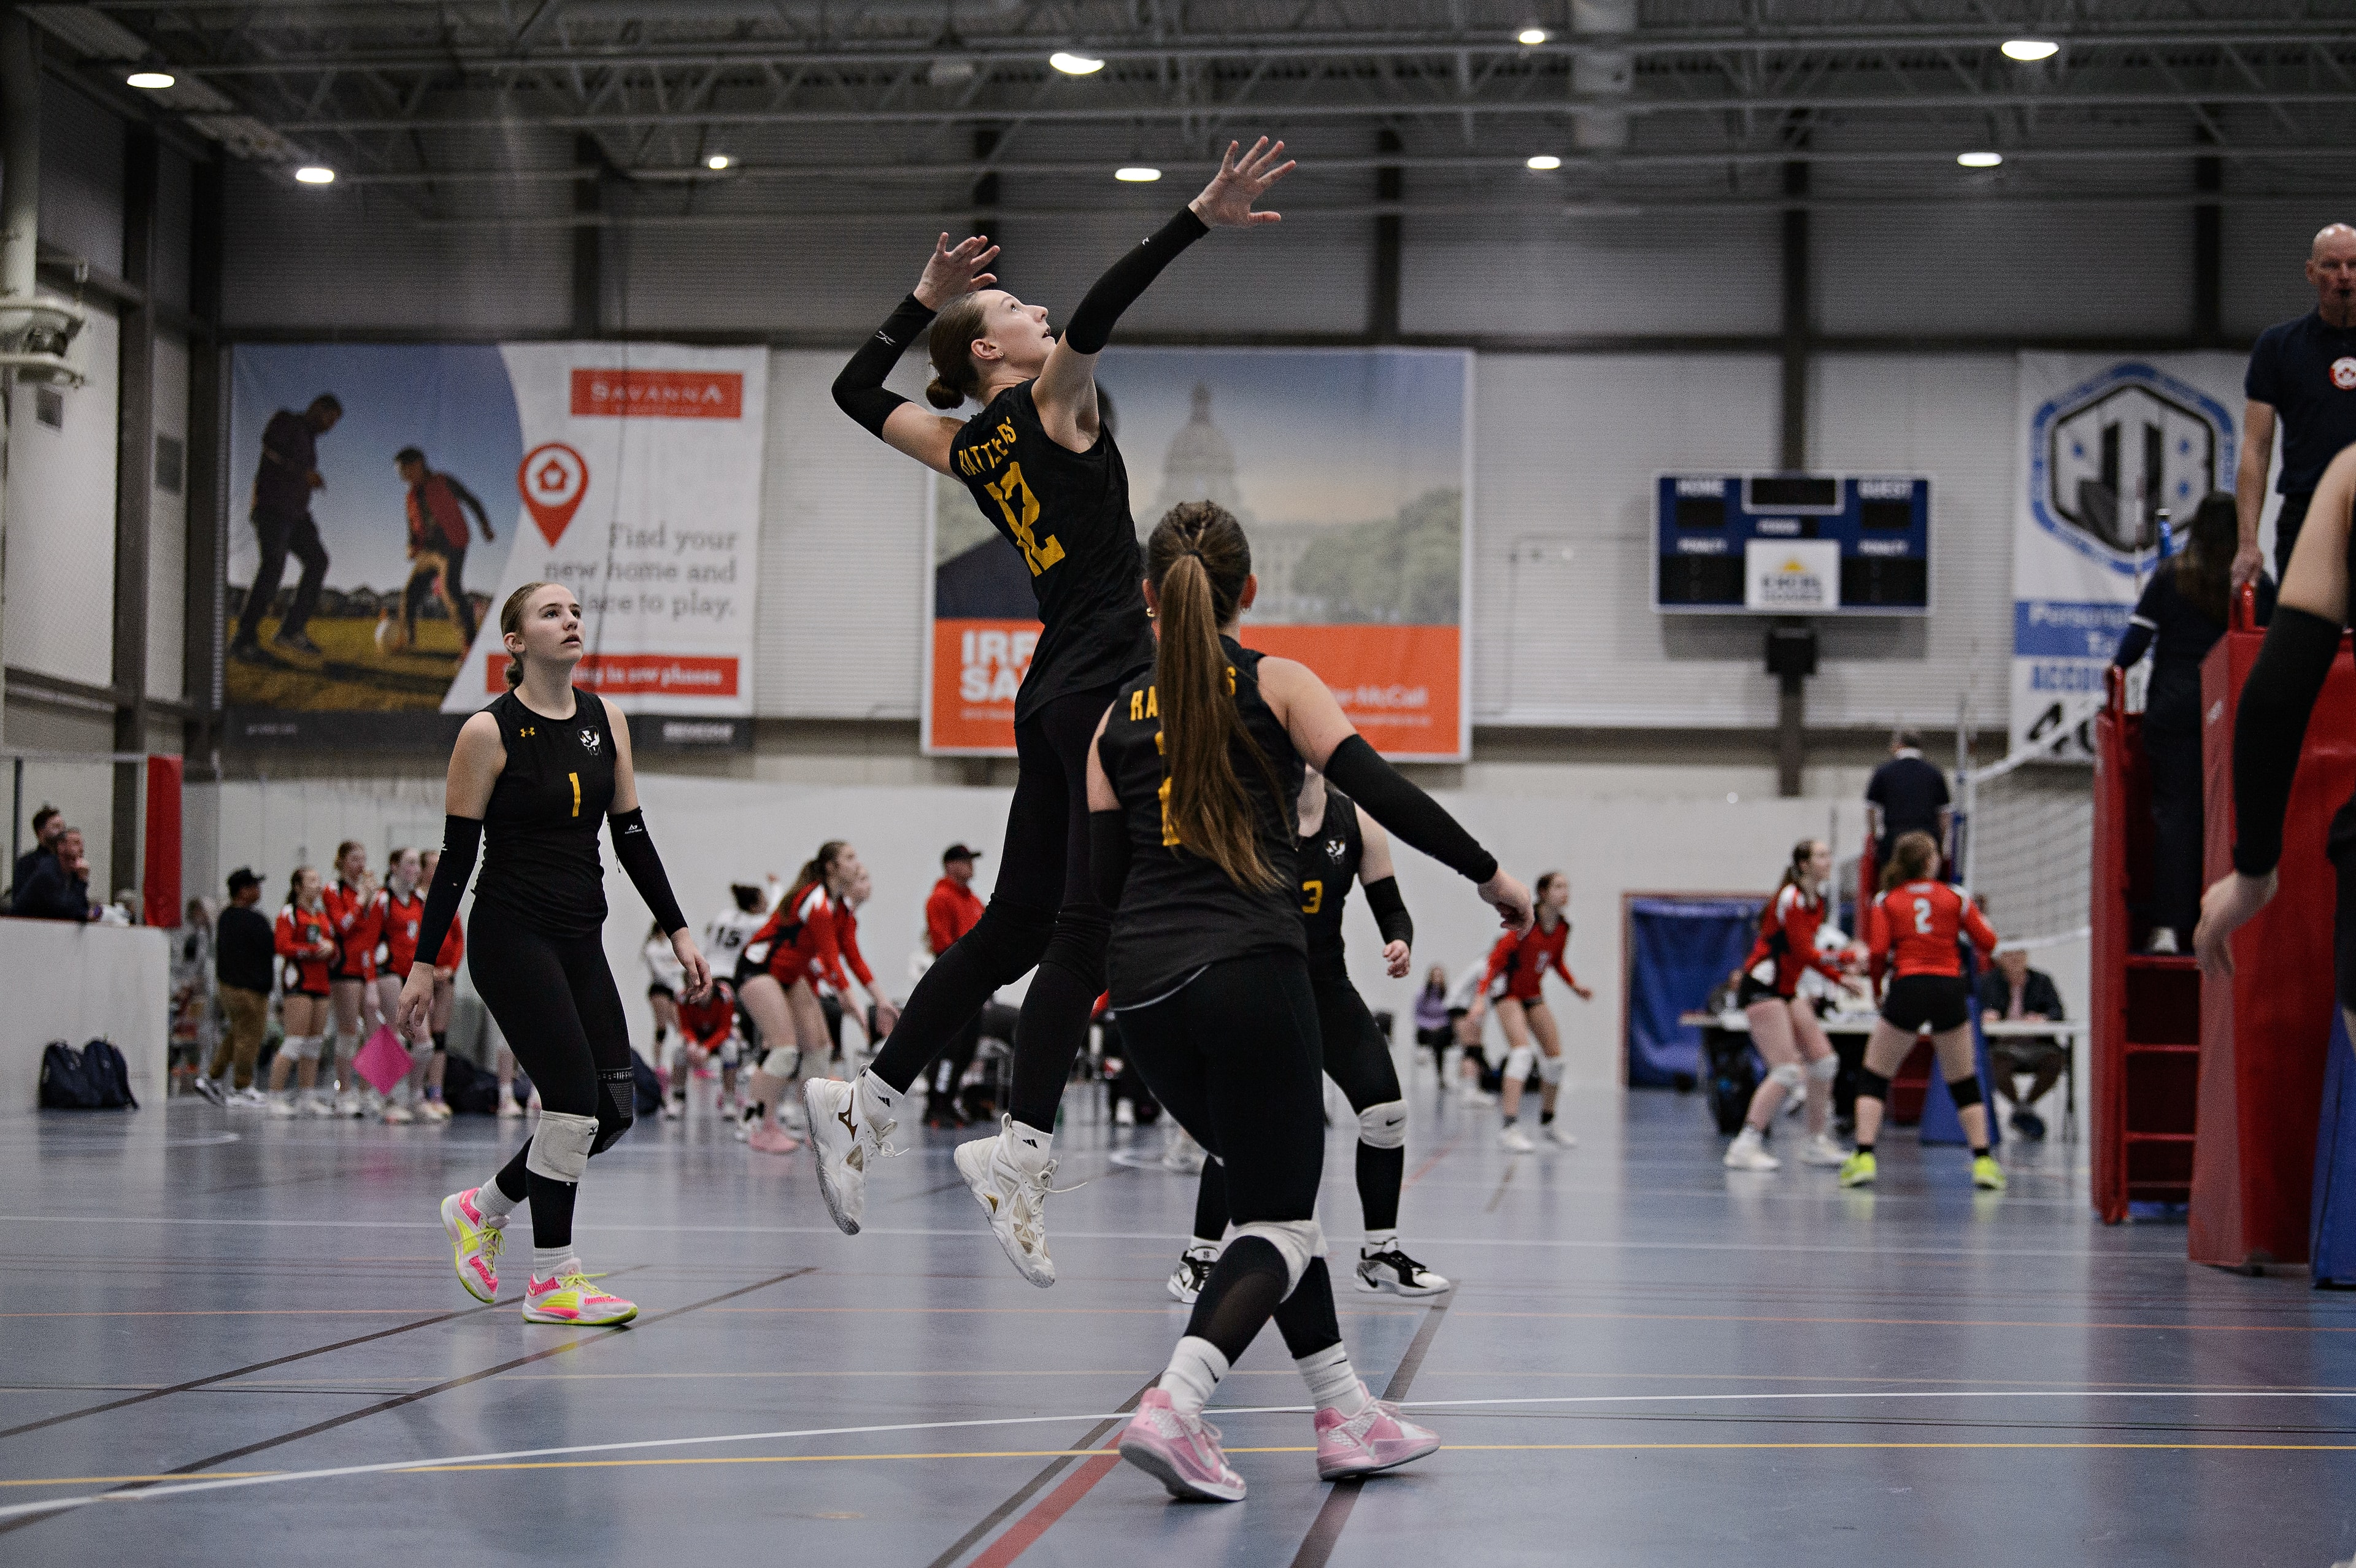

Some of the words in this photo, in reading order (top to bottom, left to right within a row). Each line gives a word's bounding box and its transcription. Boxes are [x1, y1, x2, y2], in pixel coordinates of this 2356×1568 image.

[984, 461, 1066, 577] 12
[609, 521, 666, 548] Find
[674, 529, 738, 555] your
[544, 561, 598, 579] new
[687, 556, 736, 582] and
[577, 584, 633, 611] lace
[638, 591, 664, 612] to
[961, 630, 1039, 666] IRF
[960, 666, 1028, 701] SA
[569, 772, 581, 817] 1
[1301, 880, 1323, 914] 3
[1913, 897, 1934, 934] 2
